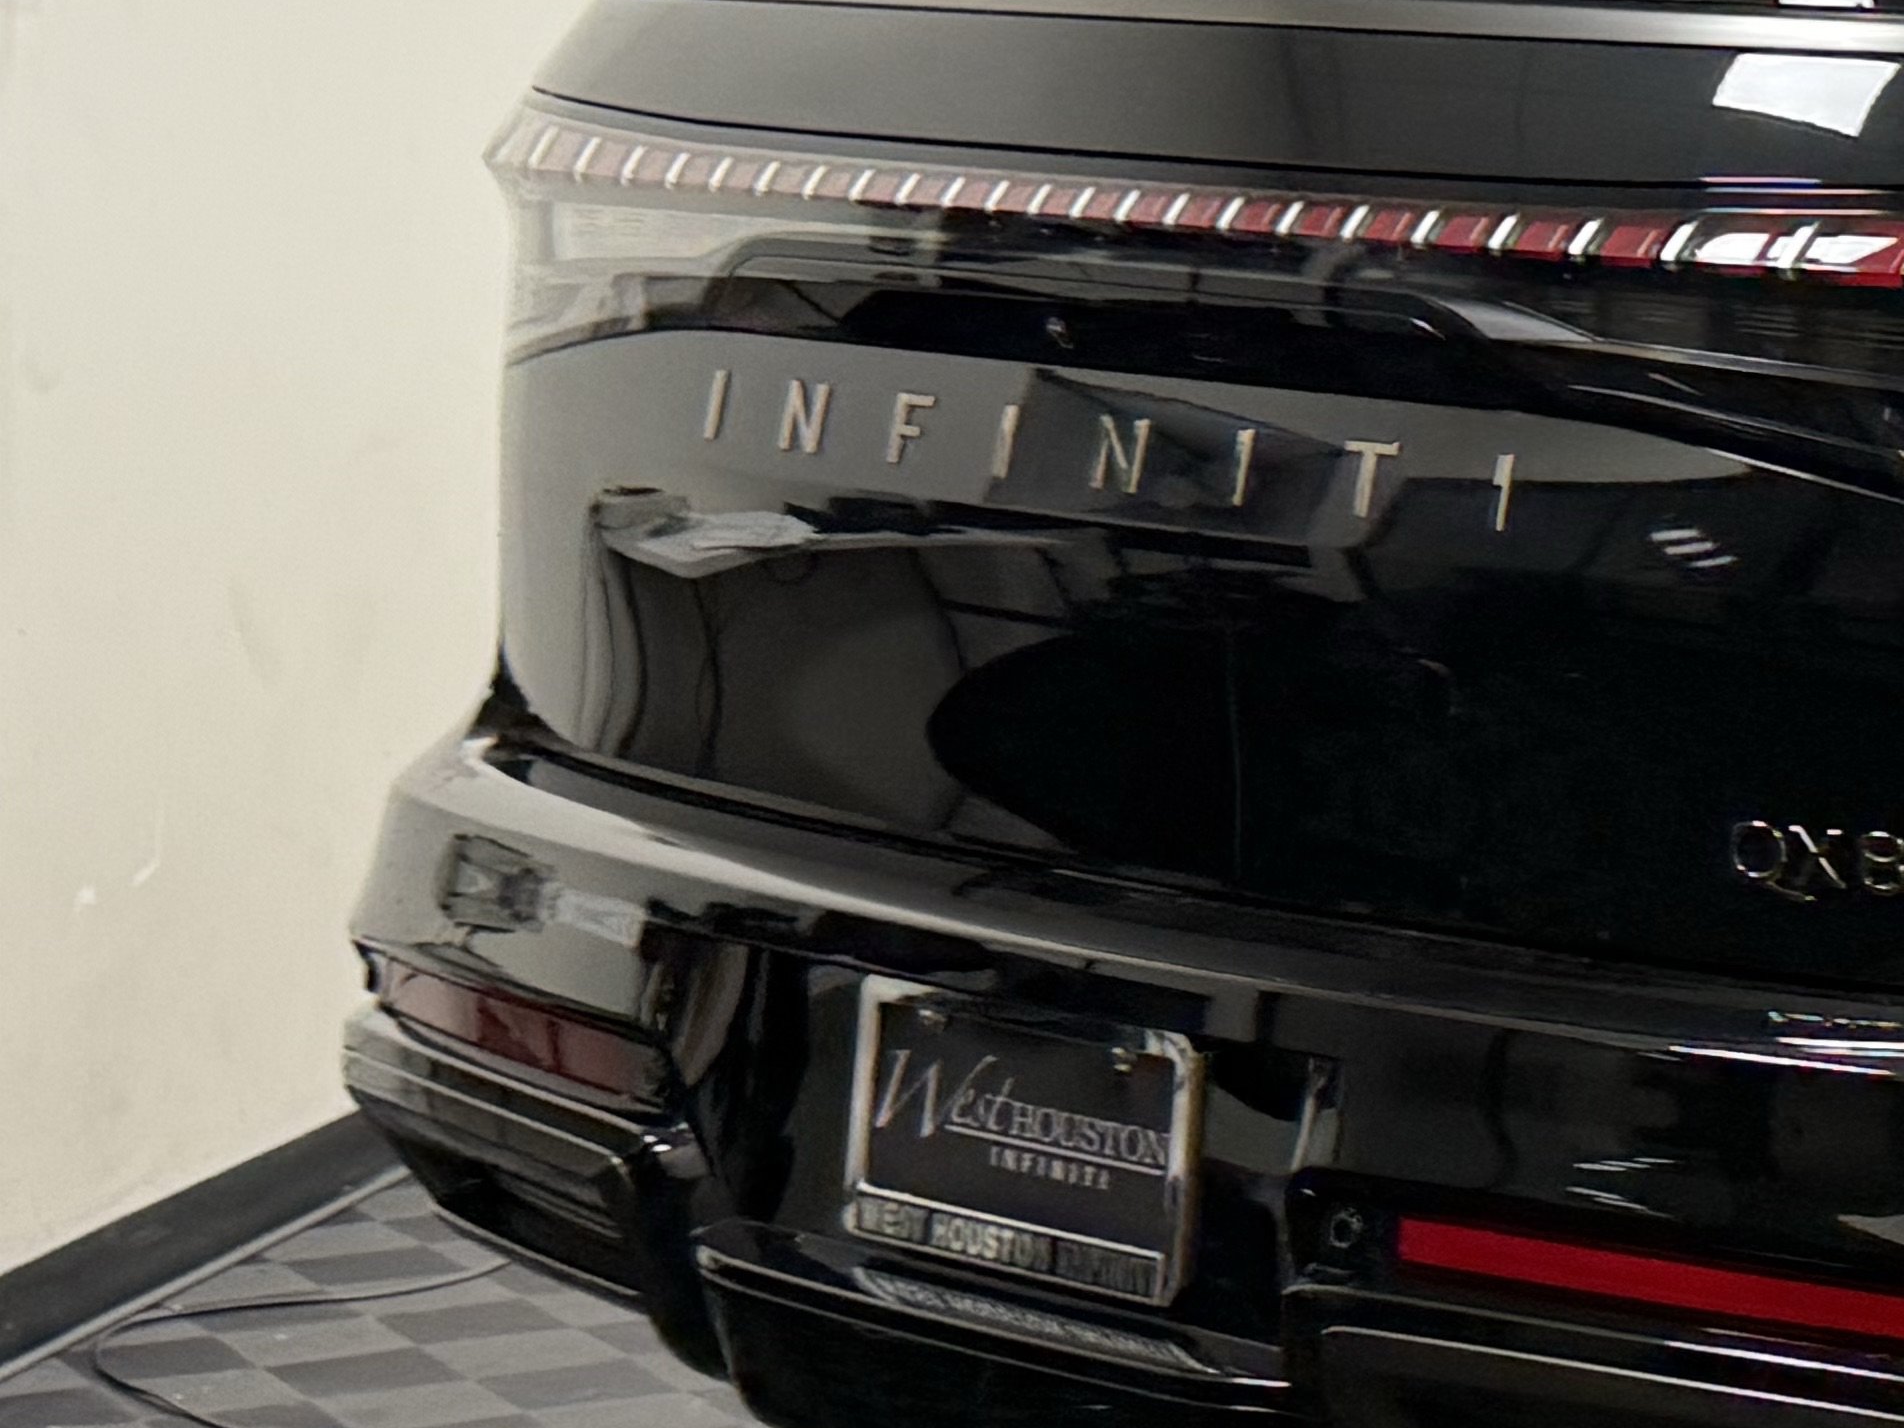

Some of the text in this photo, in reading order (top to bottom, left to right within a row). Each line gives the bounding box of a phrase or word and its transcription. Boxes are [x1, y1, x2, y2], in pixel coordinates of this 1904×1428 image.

[703, 368, 1516, 532] INFINITI
[1009, 1099, 1171, 1167] HOUSTON
[990, 1145, 1111, 1190] INFINITI
[930, 1211, 1055, 1271] HOUSTON
